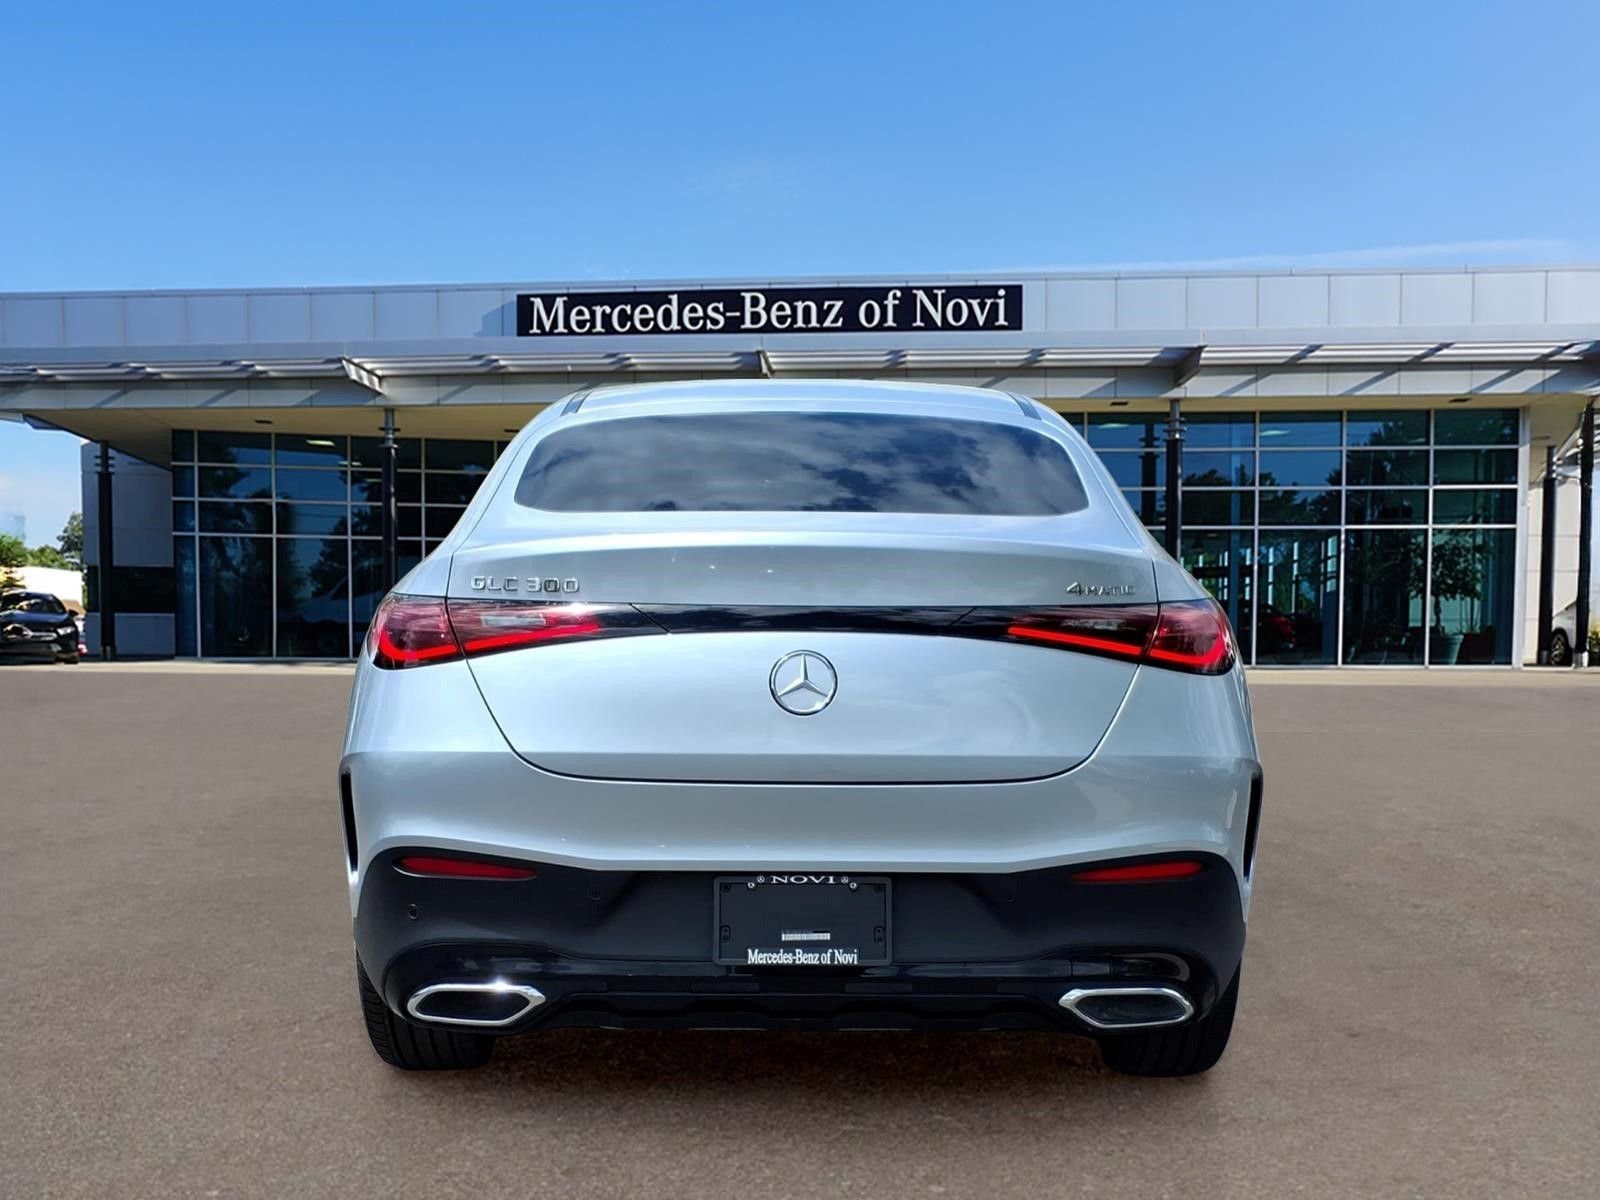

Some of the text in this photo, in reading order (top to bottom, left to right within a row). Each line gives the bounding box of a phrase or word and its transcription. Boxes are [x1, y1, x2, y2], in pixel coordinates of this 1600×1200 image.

[529, 288, 1009, 334] Mercedes-Benz of Novi
[471, 575, 580, 593] GLC 300
[1066, 581, 1135, 597] 4MATIC
[771, 875, 837, 885] NOVI
[747, 948, 858, 965] Mercedes-Benz of Novi
